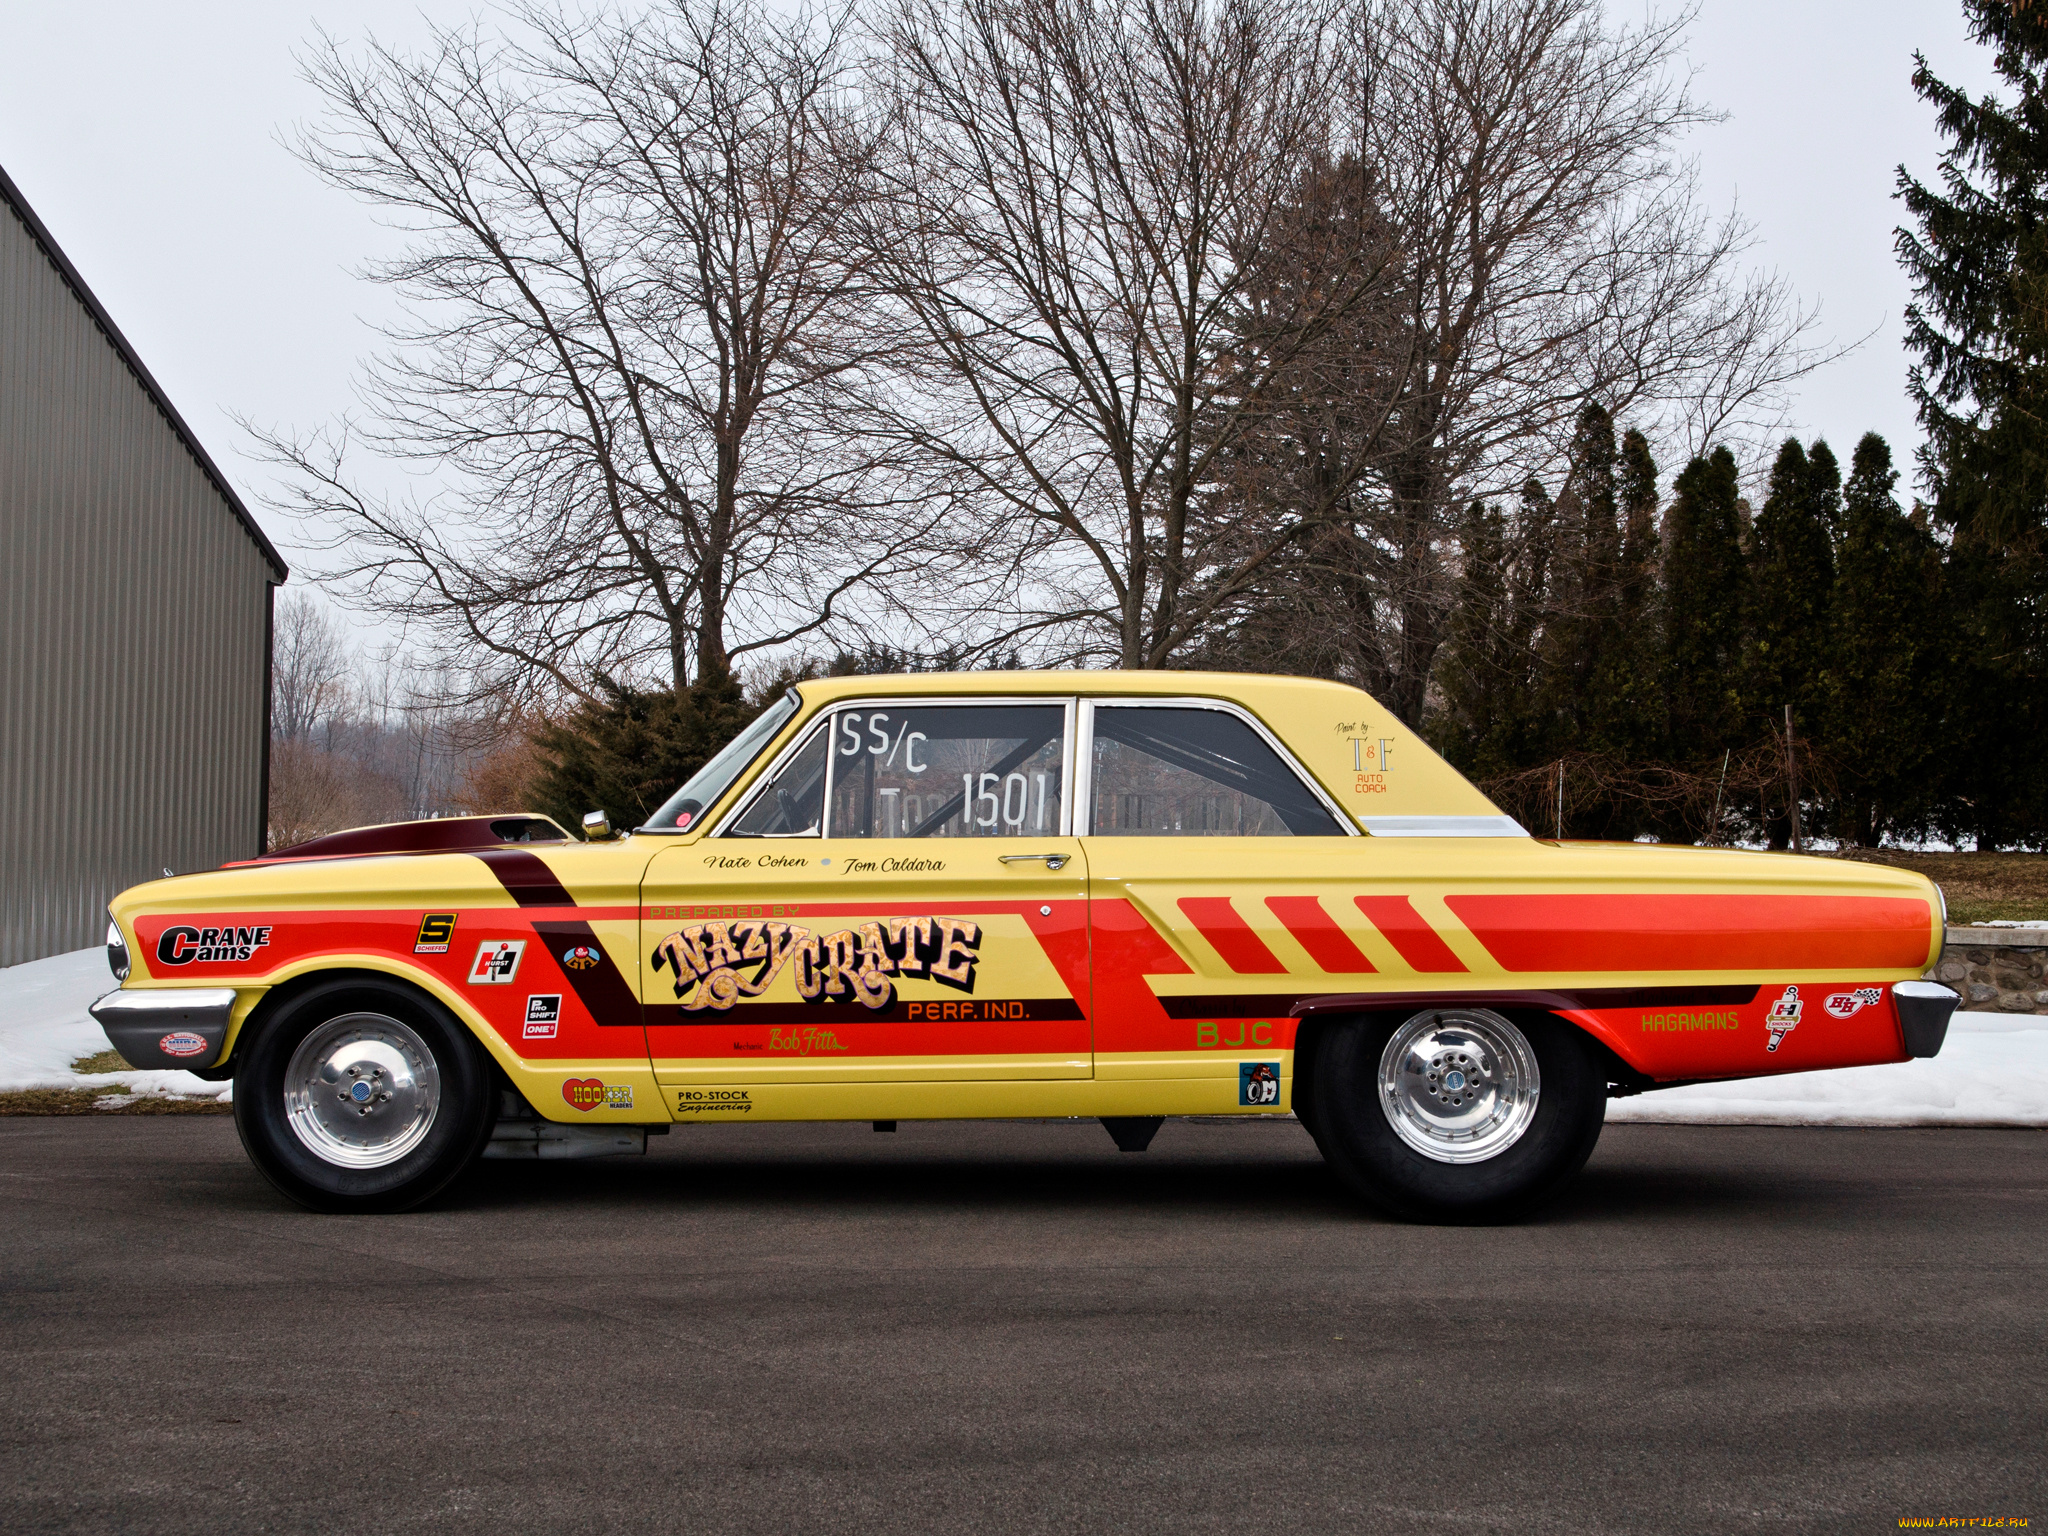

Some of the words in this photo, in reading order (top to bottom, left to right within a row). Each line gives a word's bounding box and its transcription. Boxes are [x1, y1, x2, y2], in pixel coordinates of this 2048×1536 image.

[840, 713, 928, 773] SS/C
[1357, 774, 1383, 783] AUTO
[1355, 784, 1387, 793] COACH
[963, 773, 1046, 831] 1501
[703, 855, 752, 869] Nate
[757, 854, 809, 868] Cohen
[840, 858, 878, 875] Tom
[881, 857, 947, 873] Caldara
[650, 905, 763, 919] PREPARED
[773, 905, 801, 917] BY
[794, 916, 981, 1011] CRATE
[531, 1000, 547, 1011] PRO
[908, 1002, 978, 1020] PERF.
[984, 1001, 1030, 1019] IND.
[529, 1011, 556, 1019] SHIFT
[1642, 1011, 1739, 1032] HAGAMANS
[769, 1028, 800, 1051] Bob
[1197, 1021, 1273, 1047] BJC
[573, 1086, 633, 1103] HOOKER
[678, 1091, 750, 1100] PRO-STOCK
[677, 1102, 753, 1113] Engineering
